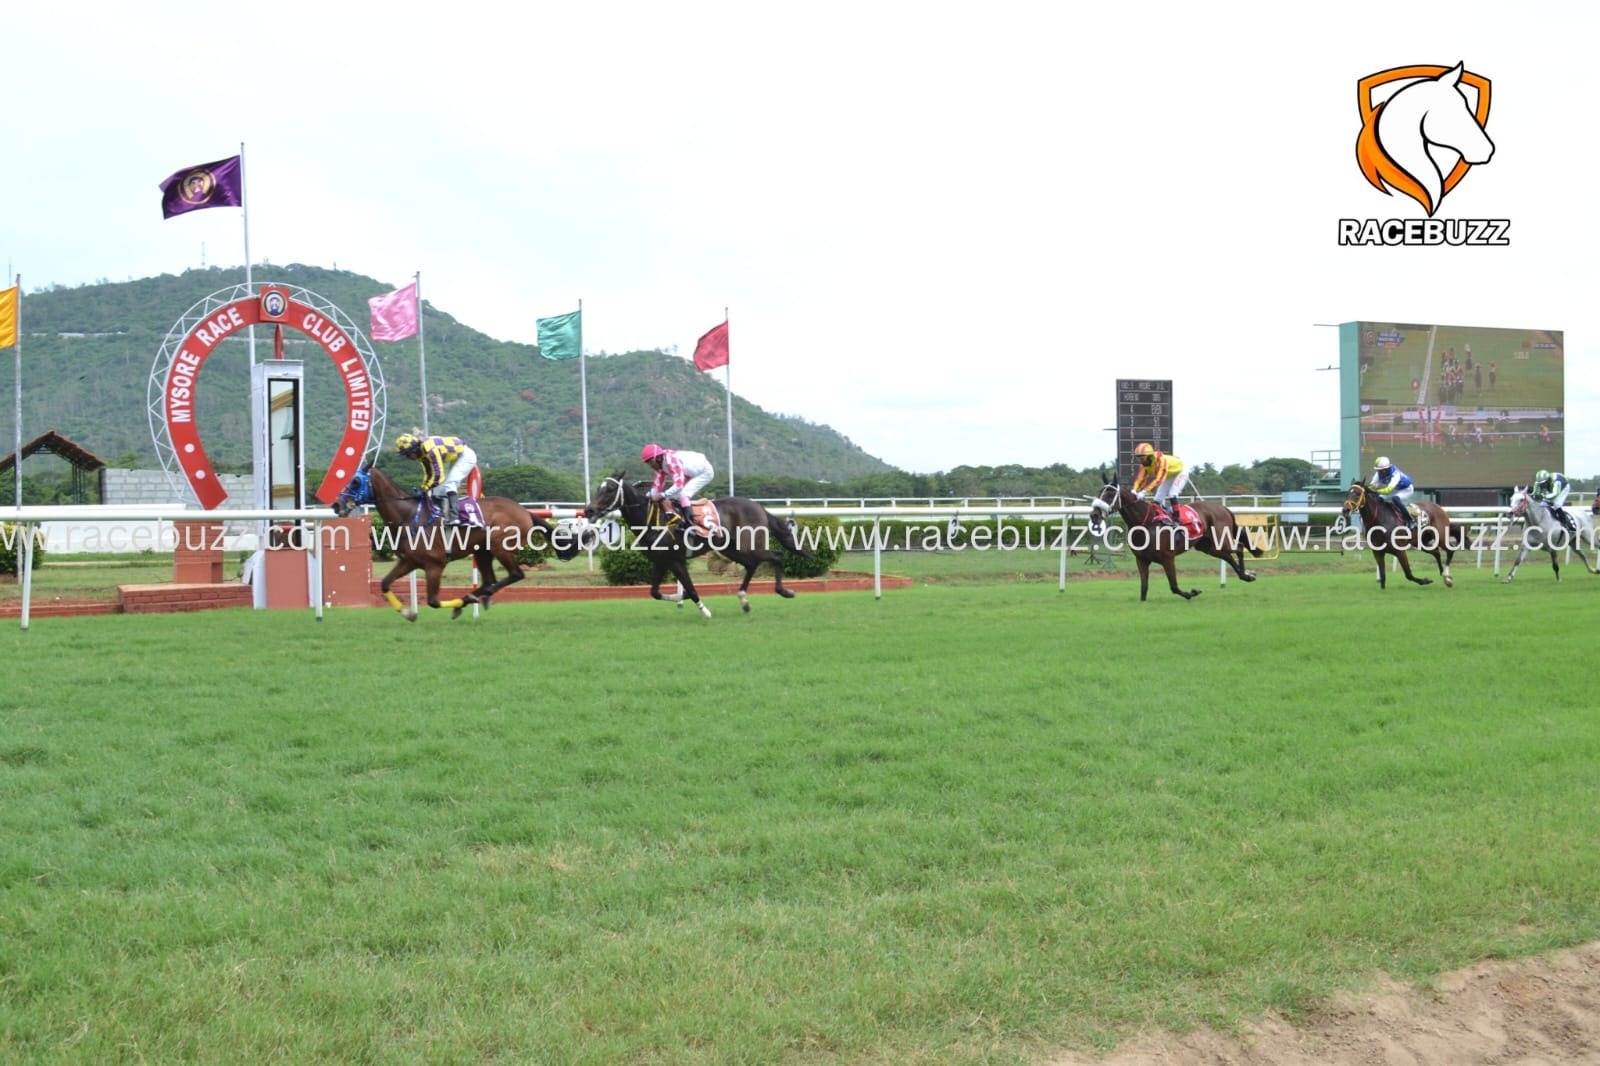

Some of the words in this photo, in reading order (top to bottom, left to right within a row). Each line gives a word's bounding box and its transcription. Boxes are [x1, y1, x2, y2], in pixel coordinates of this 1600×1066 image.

[171, 350, 201, 423] MYSORE
[195, 307, 245, 347] RACE
[302, 313, 347, 353] CLUB
[341, 357, 371, 431] LIMITED
